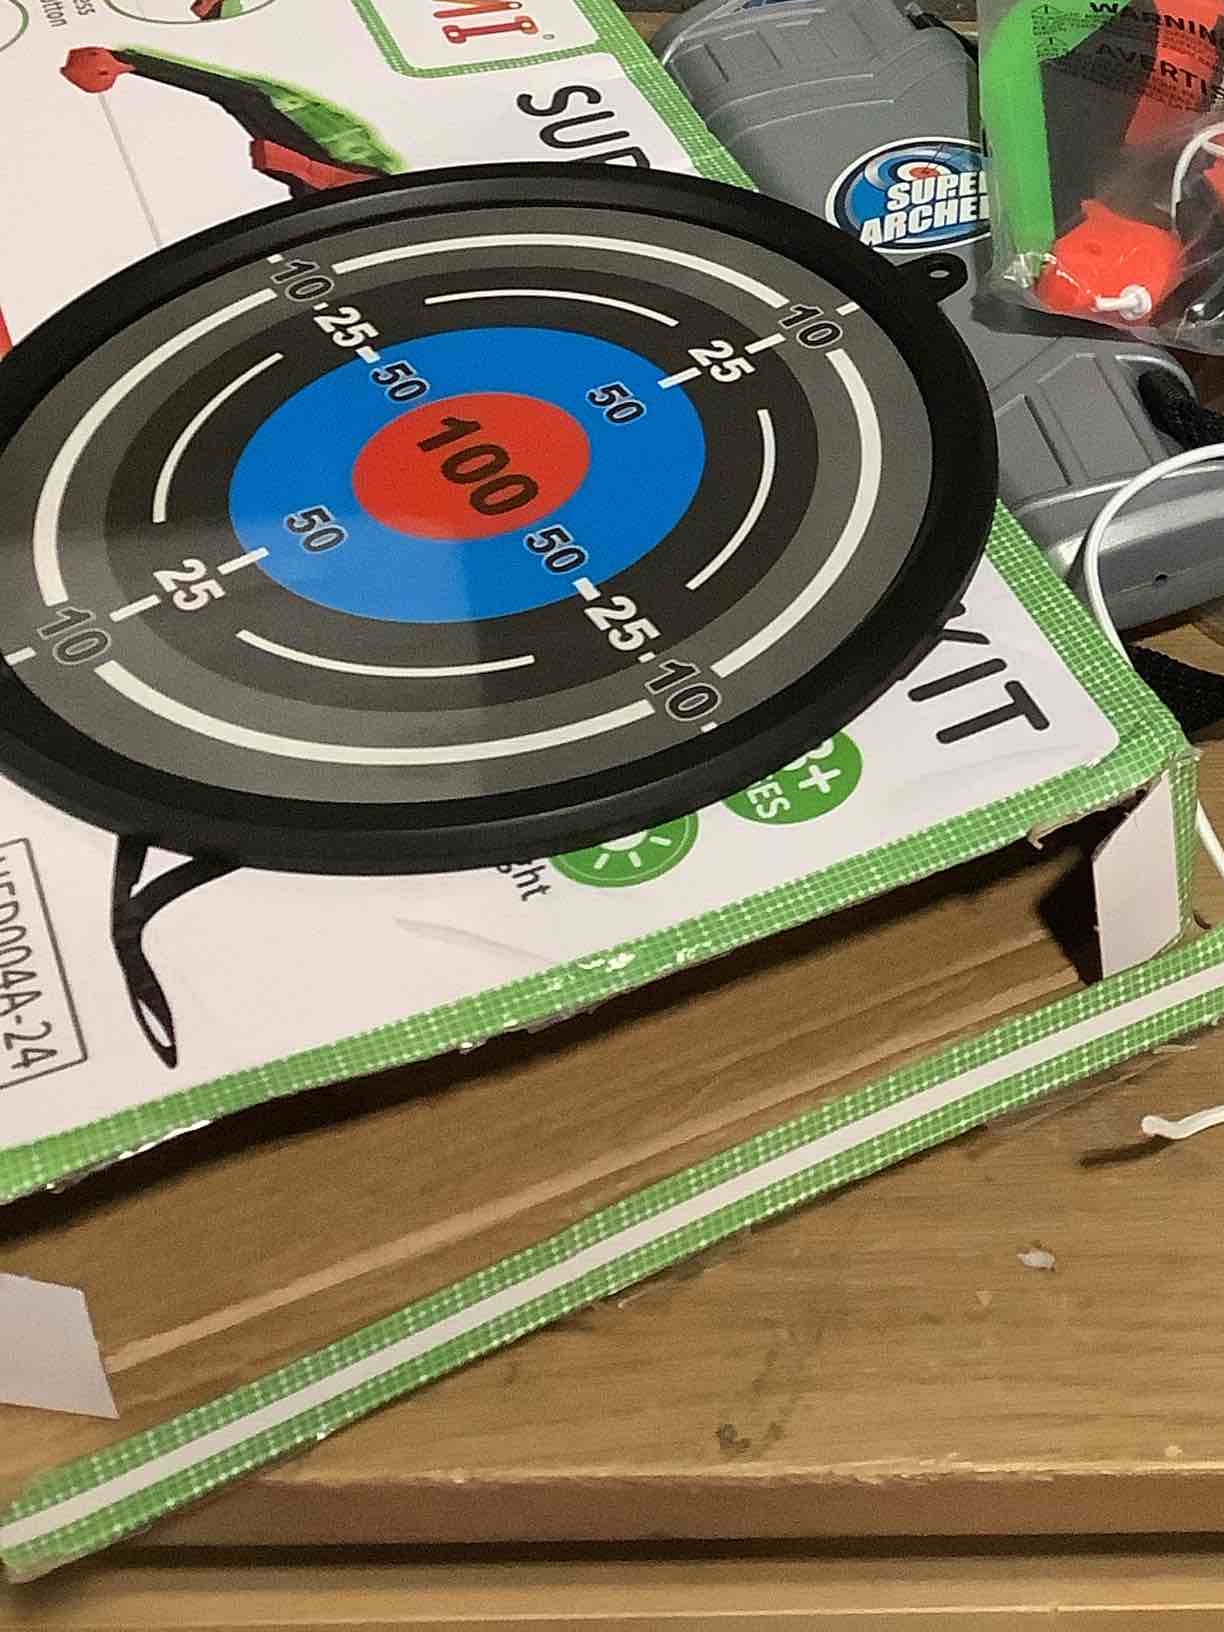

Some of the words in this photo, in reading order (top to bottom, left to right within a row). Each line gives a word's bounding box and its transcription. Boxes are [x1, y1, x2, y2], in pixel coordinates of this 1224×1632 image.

[778, 304, 843, 349] 10
[687, 339, 755, 383] 25
[586, 381, 647, 424] 50
[270, 259, 335, 302] 10
[314, 306, 380, 347] 25
[369, 360, 430, 404] 50
[416, 416, 539, 516] 100
[523, 524, 589, 575] 50
[584, 595, 661, 651] 25
[644, 659, 722, 721] 10
[283, 504, 349, 554] 50
[153, 558, 226, 611] 25
[37, 606, 112, 665] 10
[908, 601, 1050, 744] IT
[746, 775, 791, 818] ES
